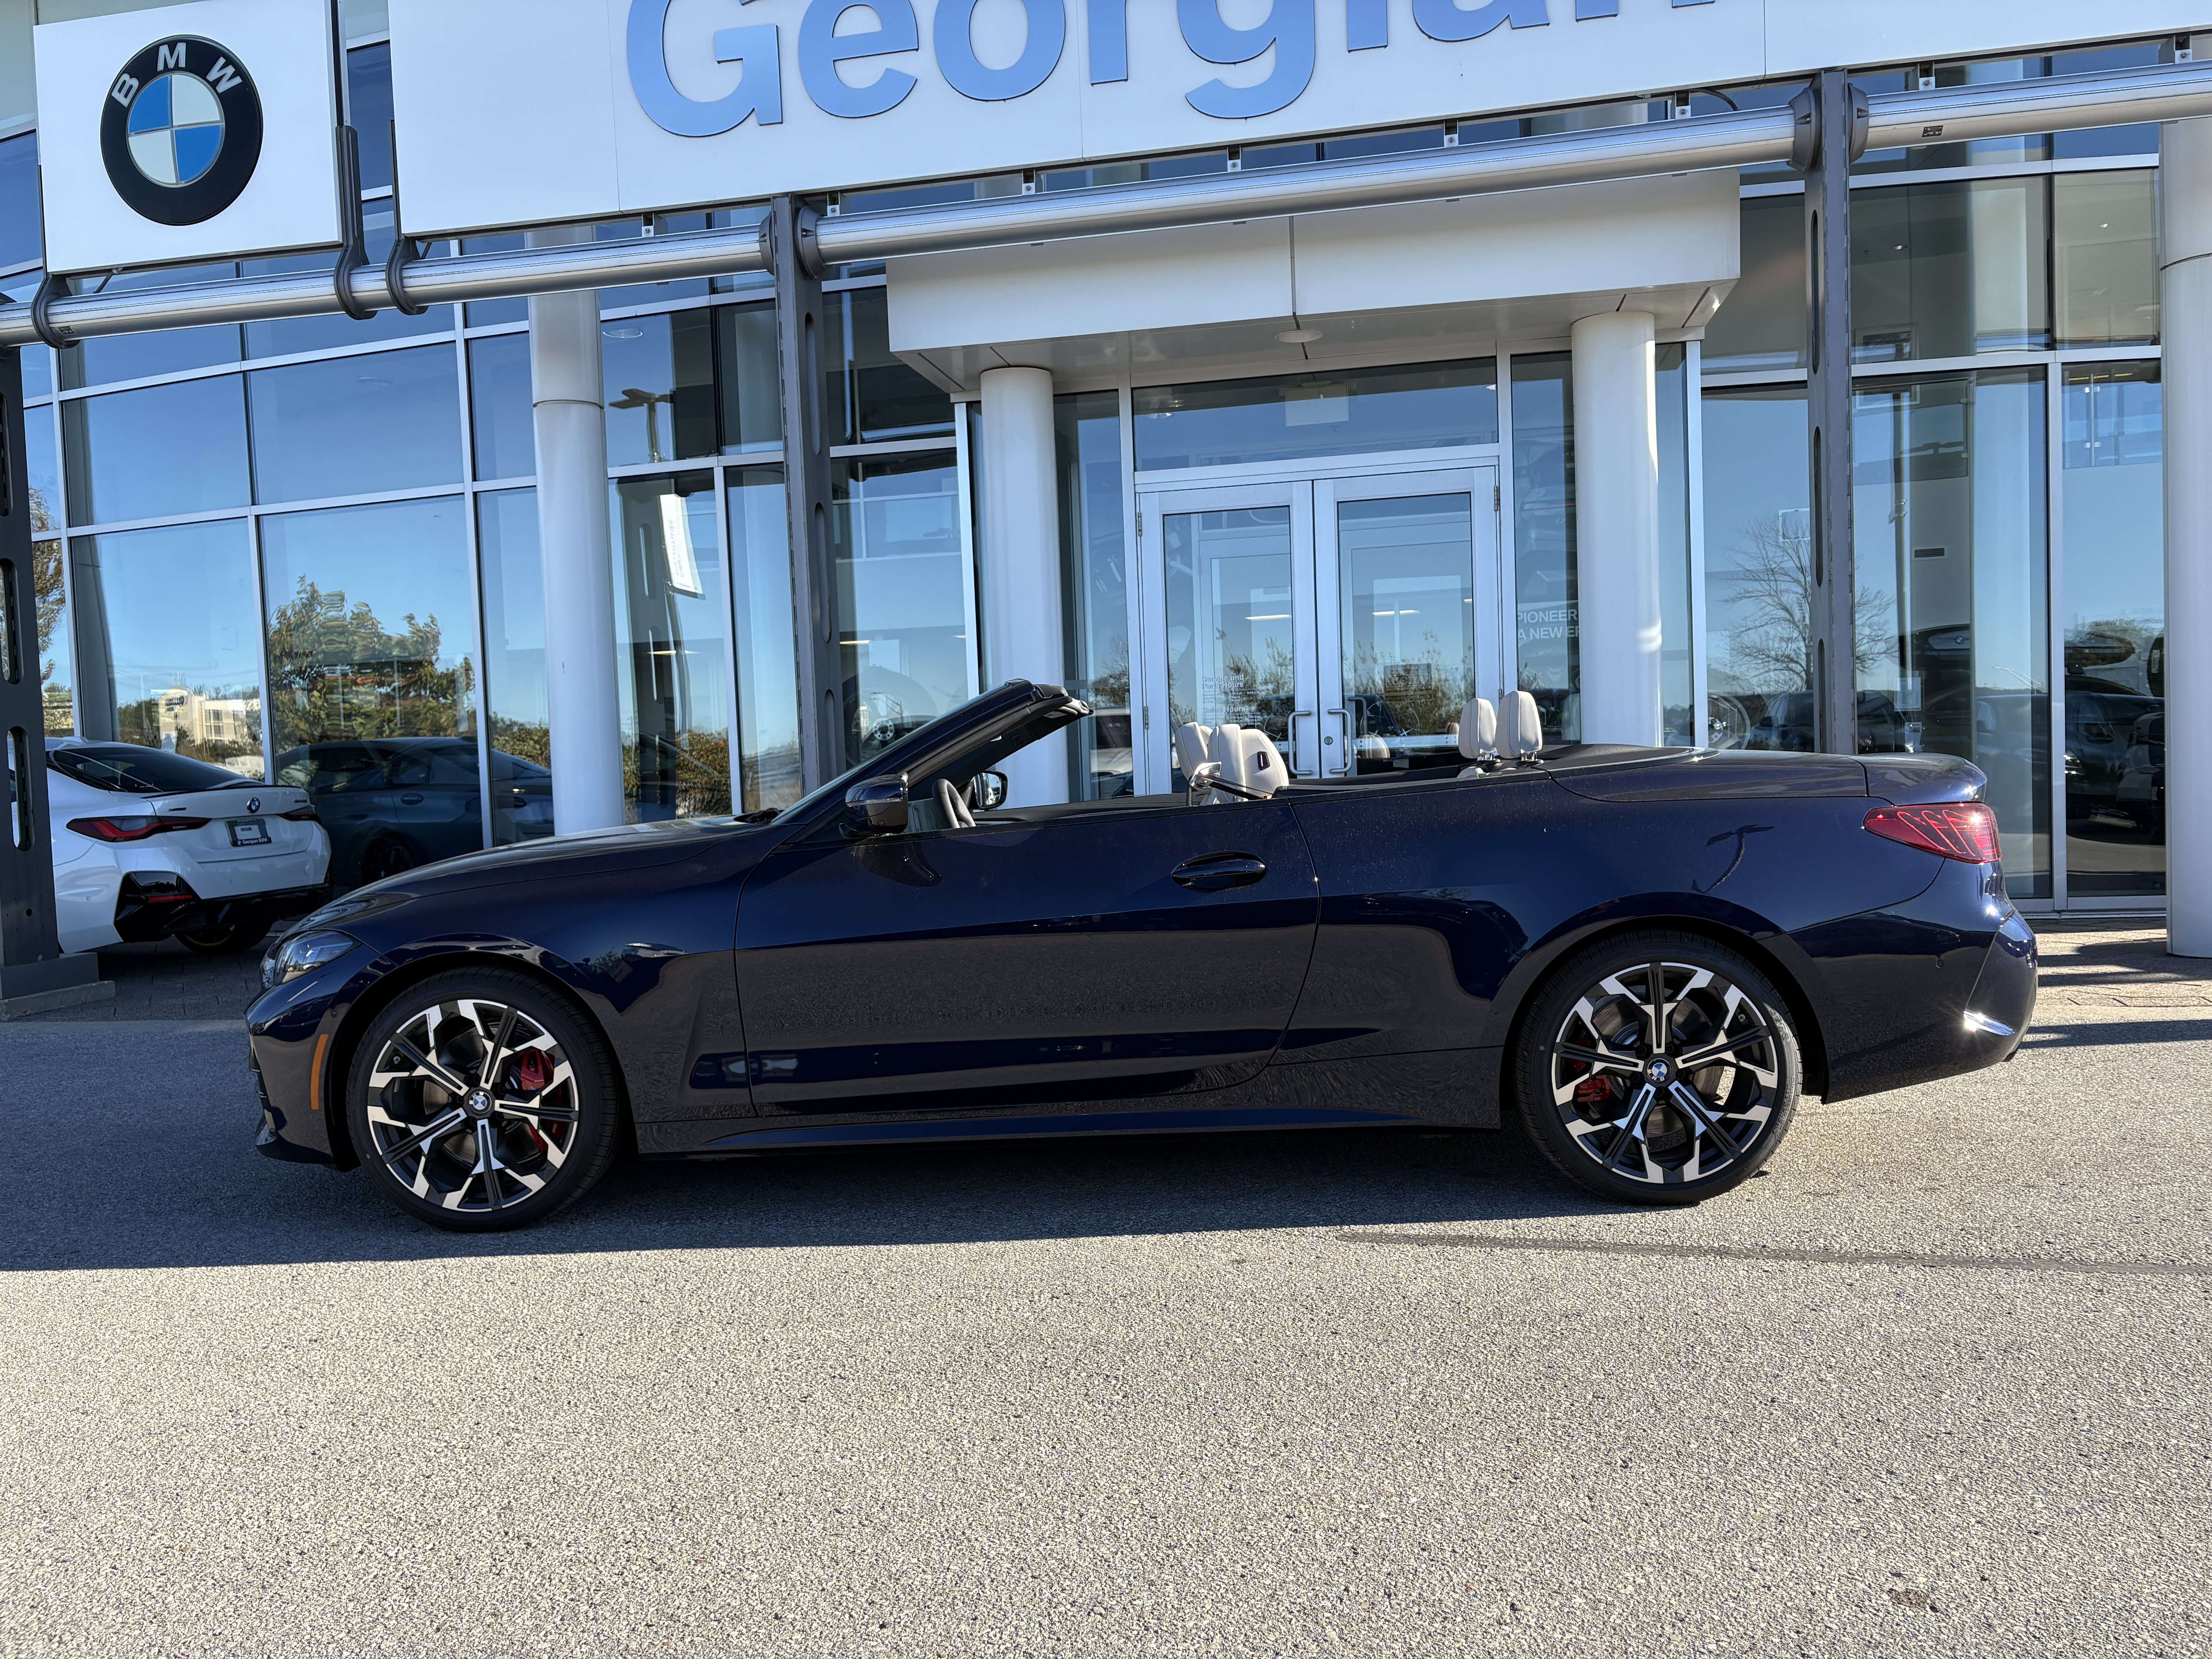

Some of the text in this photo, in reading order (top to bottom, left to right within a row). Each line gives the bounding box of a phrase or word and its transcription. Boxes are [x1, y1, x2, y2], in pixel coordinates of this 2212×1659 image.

[626, 0, 1715, 137] Georg
[111, 42, 242, 112] BMW
[2118, 617, 2164, 625] Performan
[1518, 629, 1527, 639] A
[1530, 626, 1563, 639] NEW
[1648, 1069, 1665, 1081] BMW
